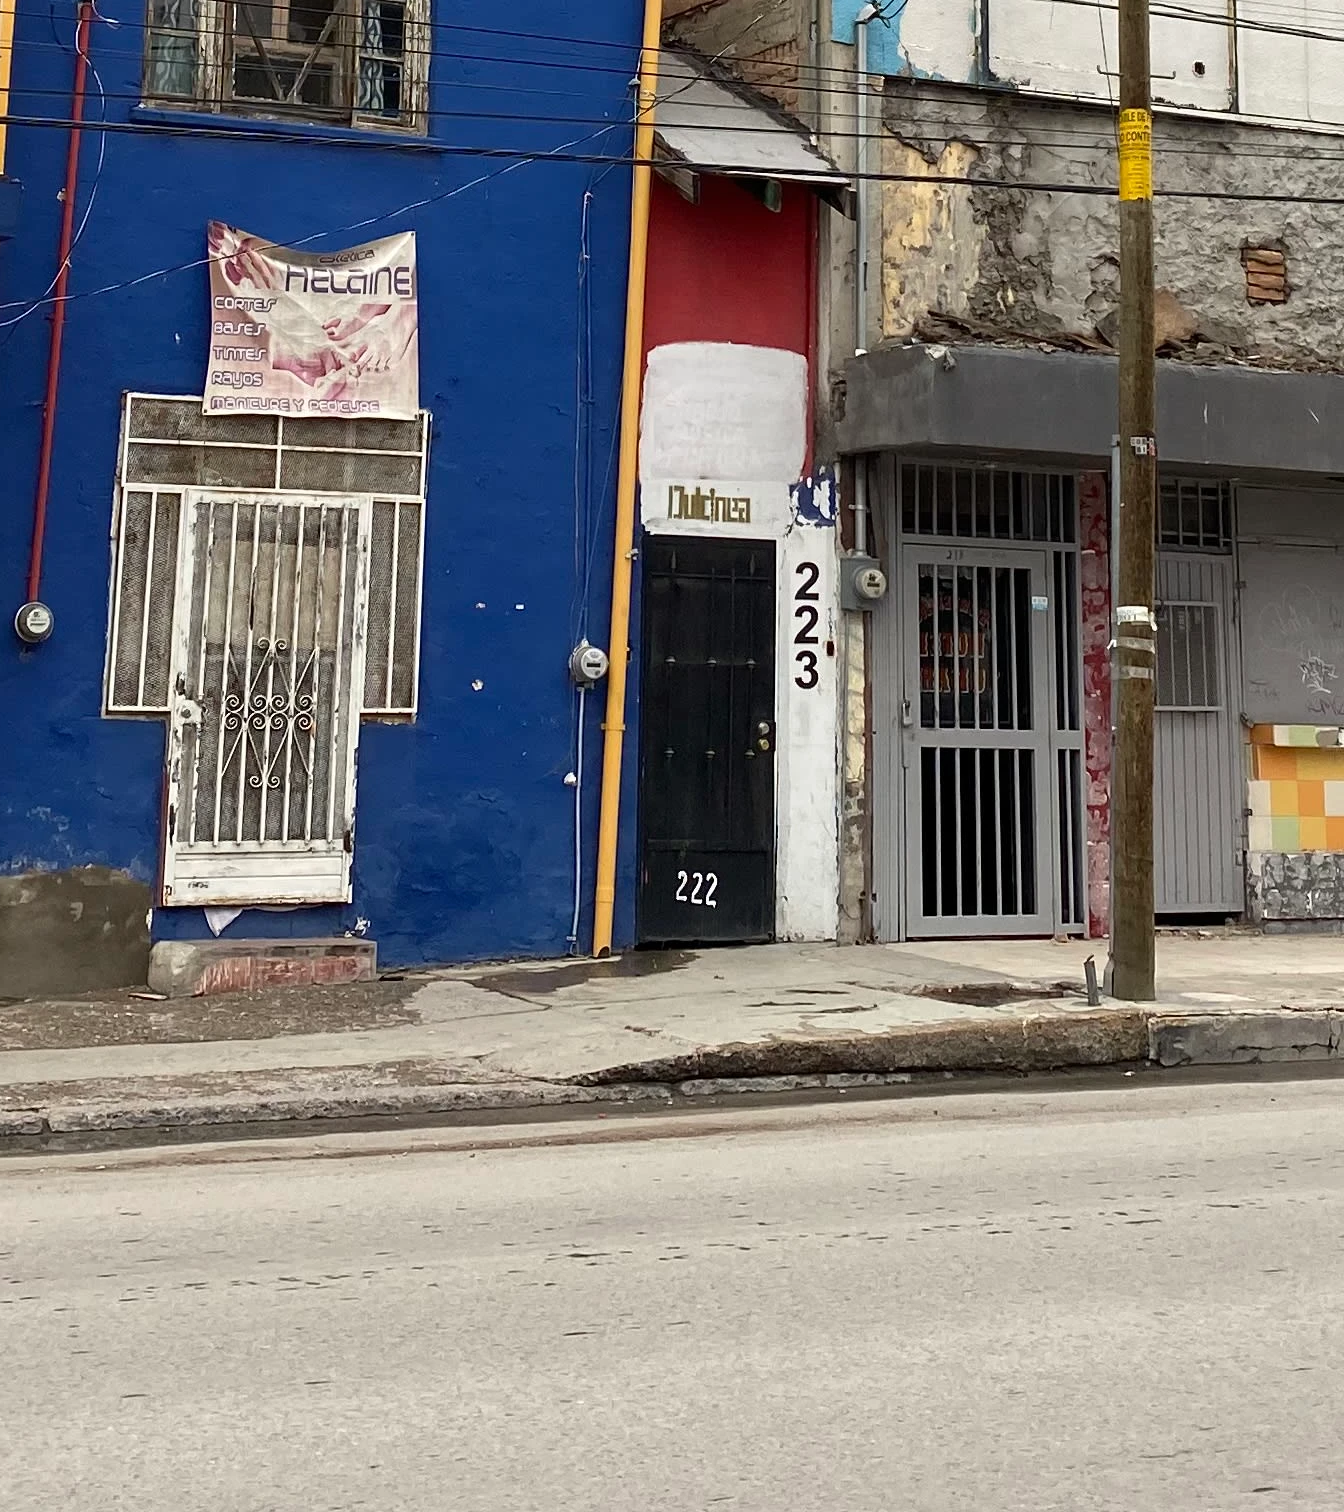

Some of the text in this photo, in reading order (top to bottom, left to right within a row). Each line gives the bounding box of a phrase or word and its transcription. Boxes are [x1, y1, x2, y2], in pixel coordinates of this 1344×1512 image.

[213, 296, 278, 312] CORTES
[293, 398, 305, 412] Y
[793, 561, 820, 690] 223
[675, 870, 718, 909] 222
